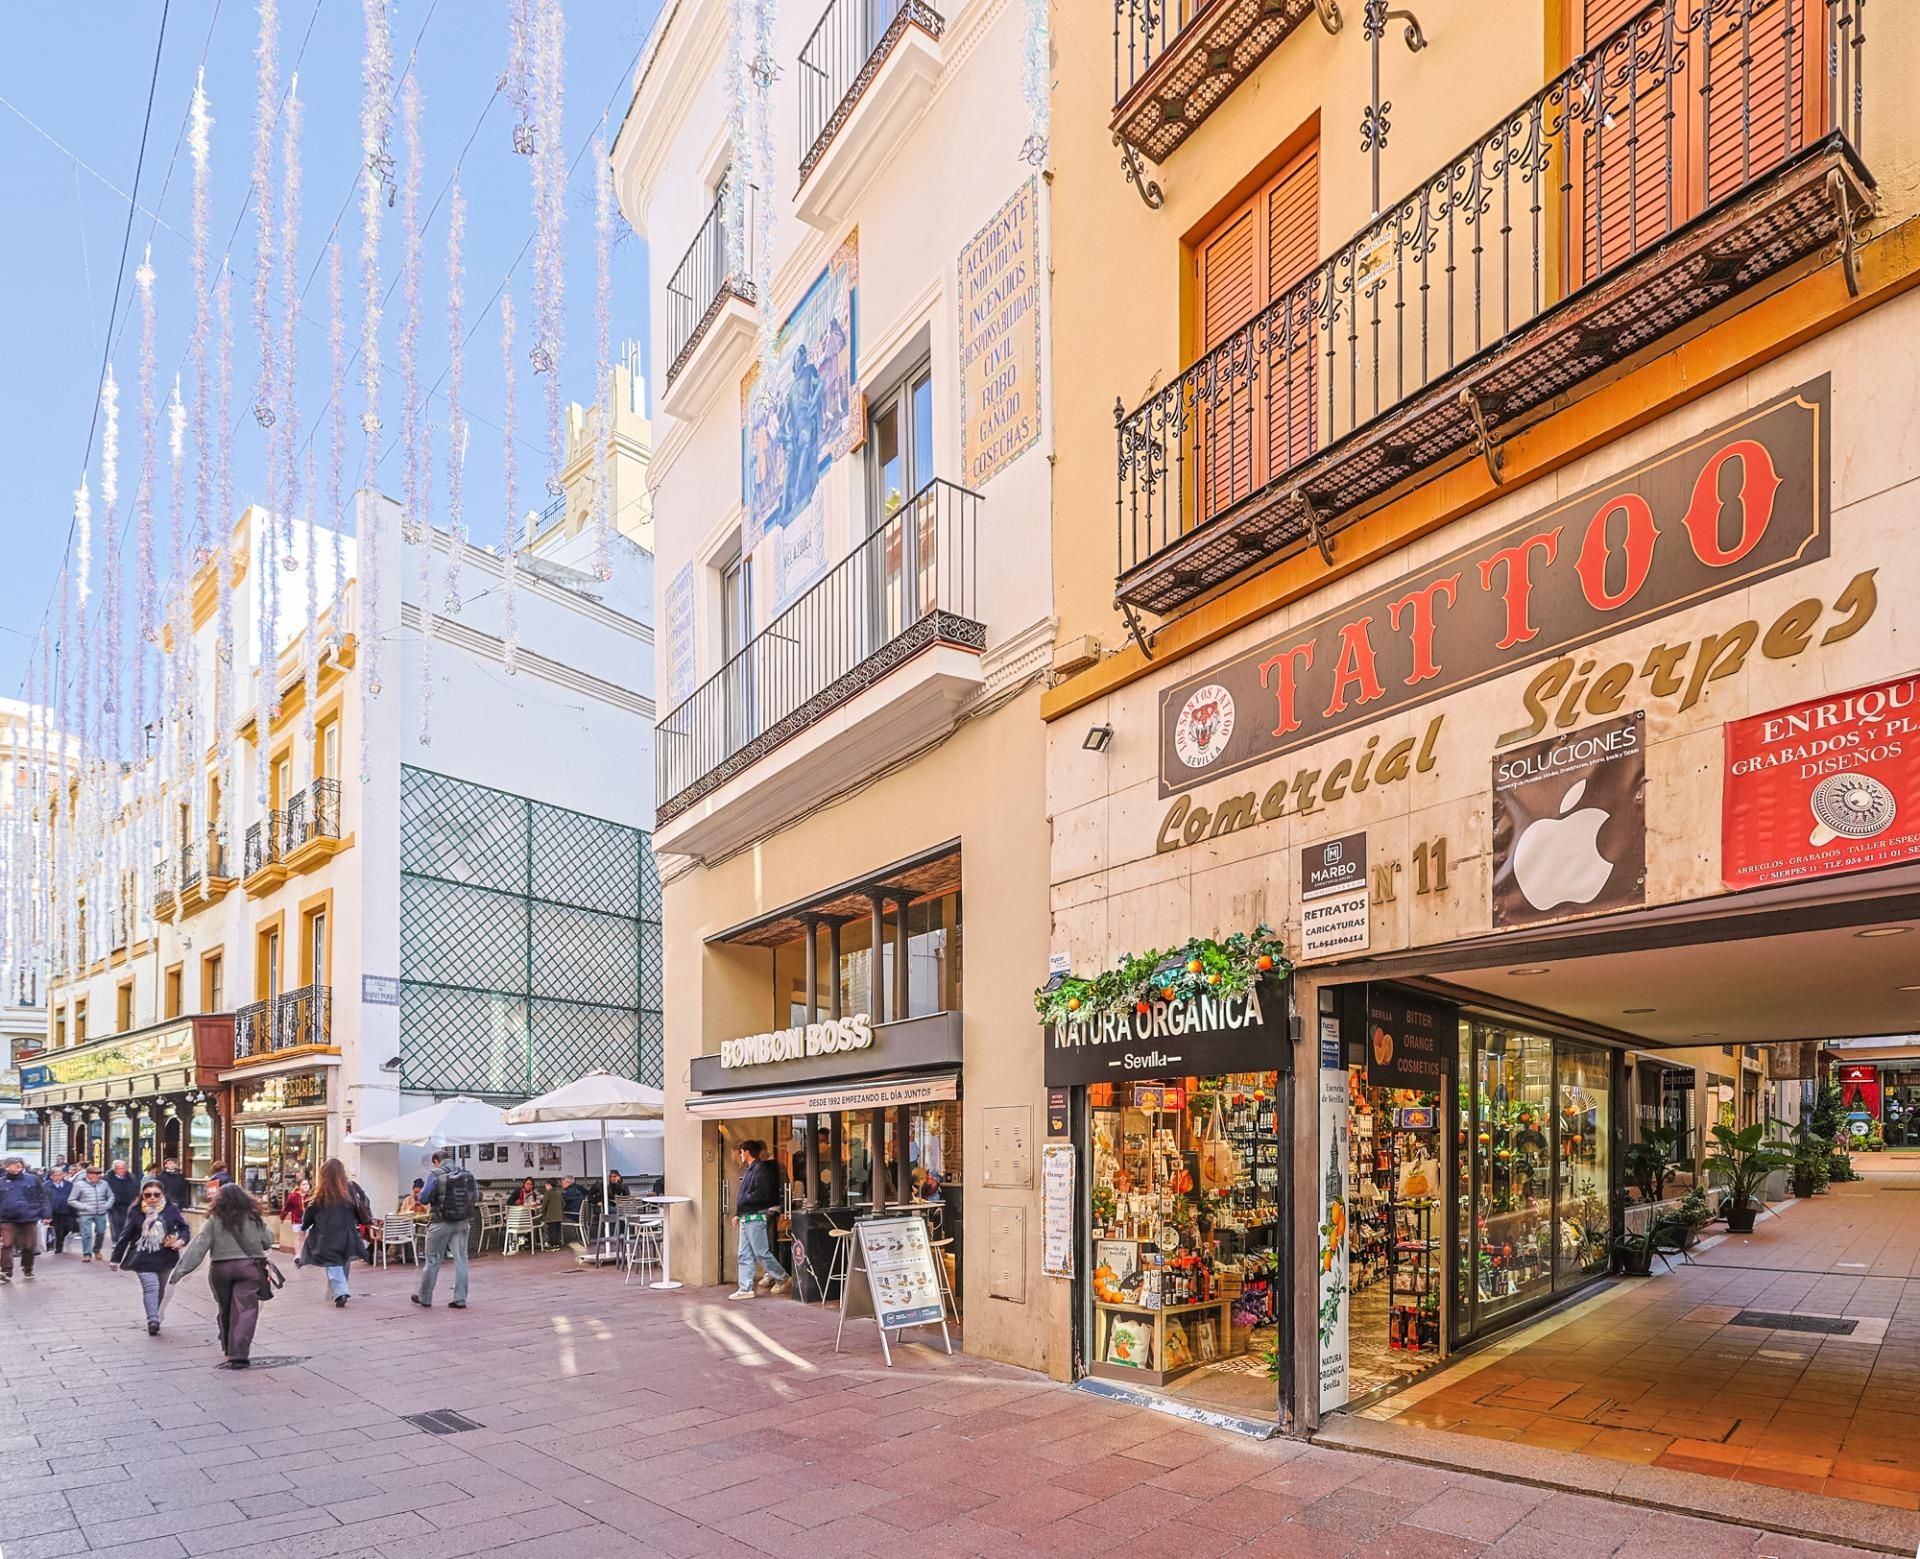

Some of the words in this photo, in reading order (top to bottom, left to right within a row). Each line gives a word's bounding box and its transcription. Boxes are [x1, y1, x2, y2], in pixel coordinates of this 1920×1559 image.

[966, 195, 1028, 279] ACCIDENTE
[969, 228, 1026, 300] INDIVIDUAL
[969, 260, 1027, 332] INCENDIOS
[965, 284, 1034, 368] RESPONSABILIDAD
[983, 335, 1014, 377] CIVIL
[982, 363, 1016, 411] ROBO
[979, 391, 1020, 443] GANADO
[972, 416, 1030, 478] COSECHAS
[1257, 438, 1784, 738] TATTOO
[1155, 713, 1445, 854] Comercial
[1495, 567, 1878, 749] Sierpes
[1178, 686, 1214, 727] SANTOS
[1214, 686, 1233, 737] TATTOO
[1760, 677, 1920, 745] ENRIQU
[1176, 728, 1188, 753] LOS
[1185, 745, 1222, 767] SEVILLA
[1498, 726, 1638, 782] SOLUCIONES
[1731, 730, 1860, 776] GRABADOS
[1799, 740, 1902, 780] DISEÑOS
[1310, 861, 1357, 883] MARBO
[1412, 836, 1449, 895] 11
[1736, 859, 1784, 875] ARREGLOS
[1789, 848, 1841, 866] GRABADOS
[1848, 839, 1886, 855] TALLER
[1770, 865, 1807, 880] SIERPES
[1845, 856, 1862, 867] 954
[1864, 853, 1875, 863] 21
[1304, 899, 1366, 921] RETRATOS
[1305, 918, 1366, 937] CARICATURAS
[1054, 1008, 1133, 1049] NATURA
[1371, 1008, 1393, 1021] SEVILLA
[1405, 1009, 1433, 1028] BITTER
[720, 1028, 804, 1069] BOMBON
[805, 1013, 873, 1056] BOSS
[1124, 1051, 1168, 1070] Sevilla
[1403, 1034, 1434, 1052] ORANGE
[1397, 1057, 1440, 1076] COSMETICS
[808, 1099, 828, 1108] DESDE
[828, 1097, 841, 1106] 1992
[842, 1093, 880, 1105] EMPEZANDO
[880, 1092, 889, 1102] EL
[890, 1088, 902, 1100] DÍA
[904, 1087, 932, 1099] JUNTOS
[1321, 1094, 1328, 1103] de
[1328, 1094, 1344, 1104] Sevilla
[1325, 1083, 1345, 1093] Esencia
[1322, 1353, 1342, 1367] NATURA
[1323, 1380, 1341, 1392] Sevilla
